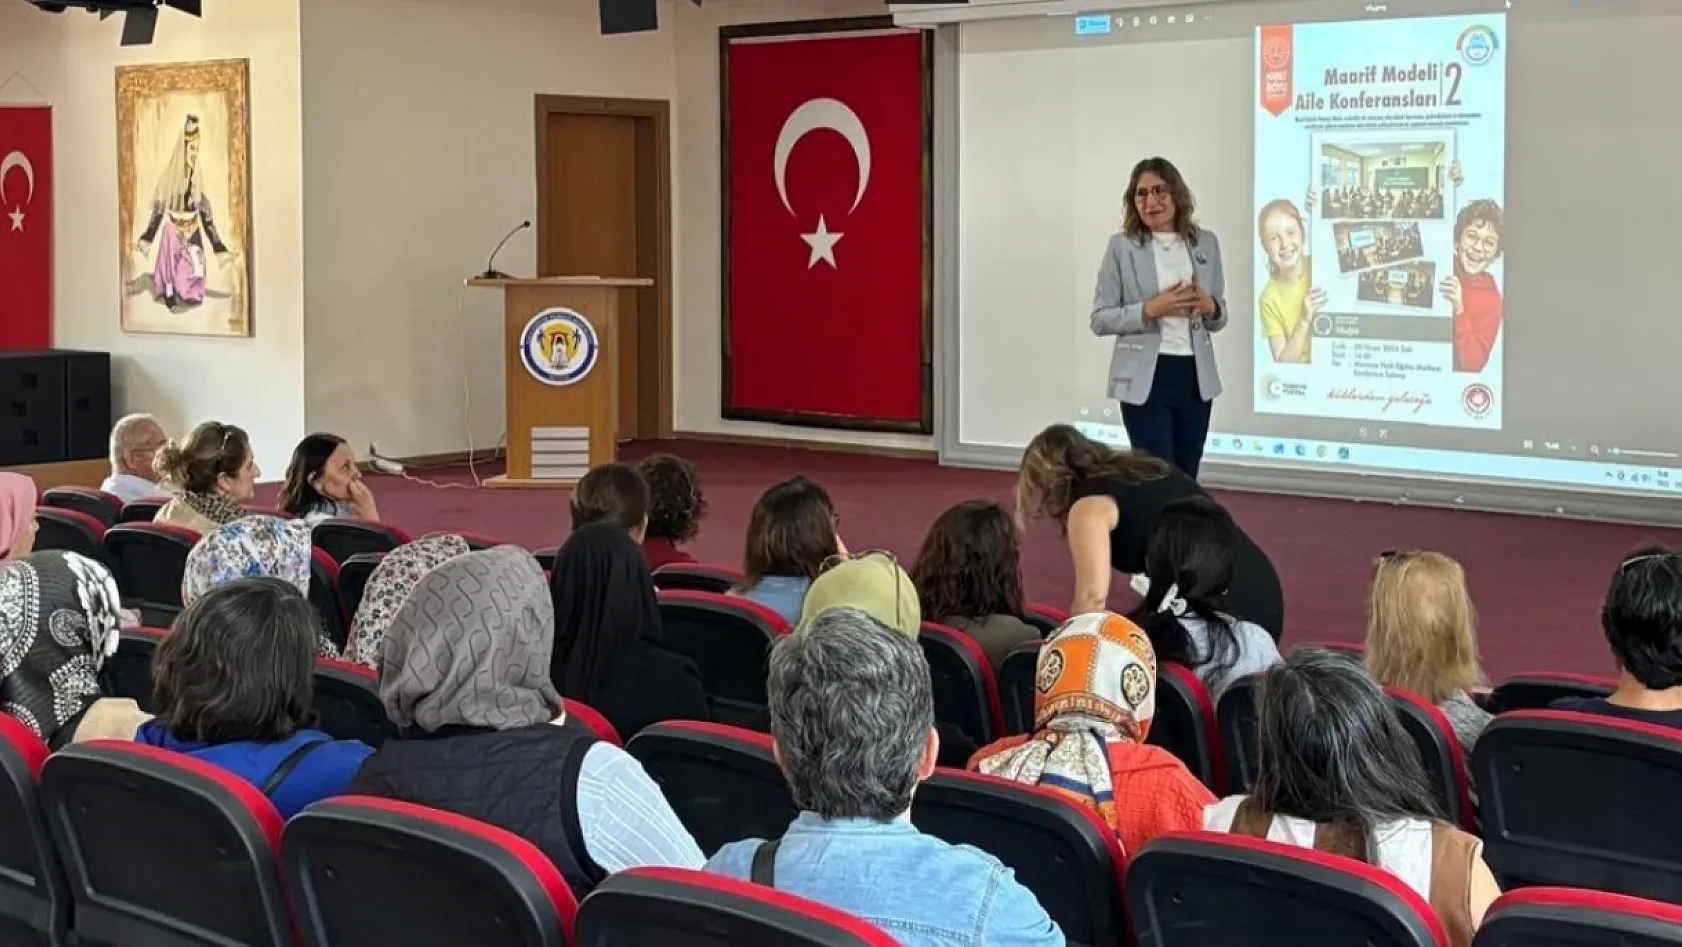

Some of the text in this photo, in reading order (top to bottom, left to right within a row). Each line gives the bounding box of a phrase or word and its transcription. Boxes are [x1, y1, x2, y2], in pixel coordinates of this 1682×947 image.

[1323, 62, 1437, 87] Maarif Modeli
[1445, 61, 1462, 106] 2
[1295, 88, 1437, 111] Aile Konferansları
